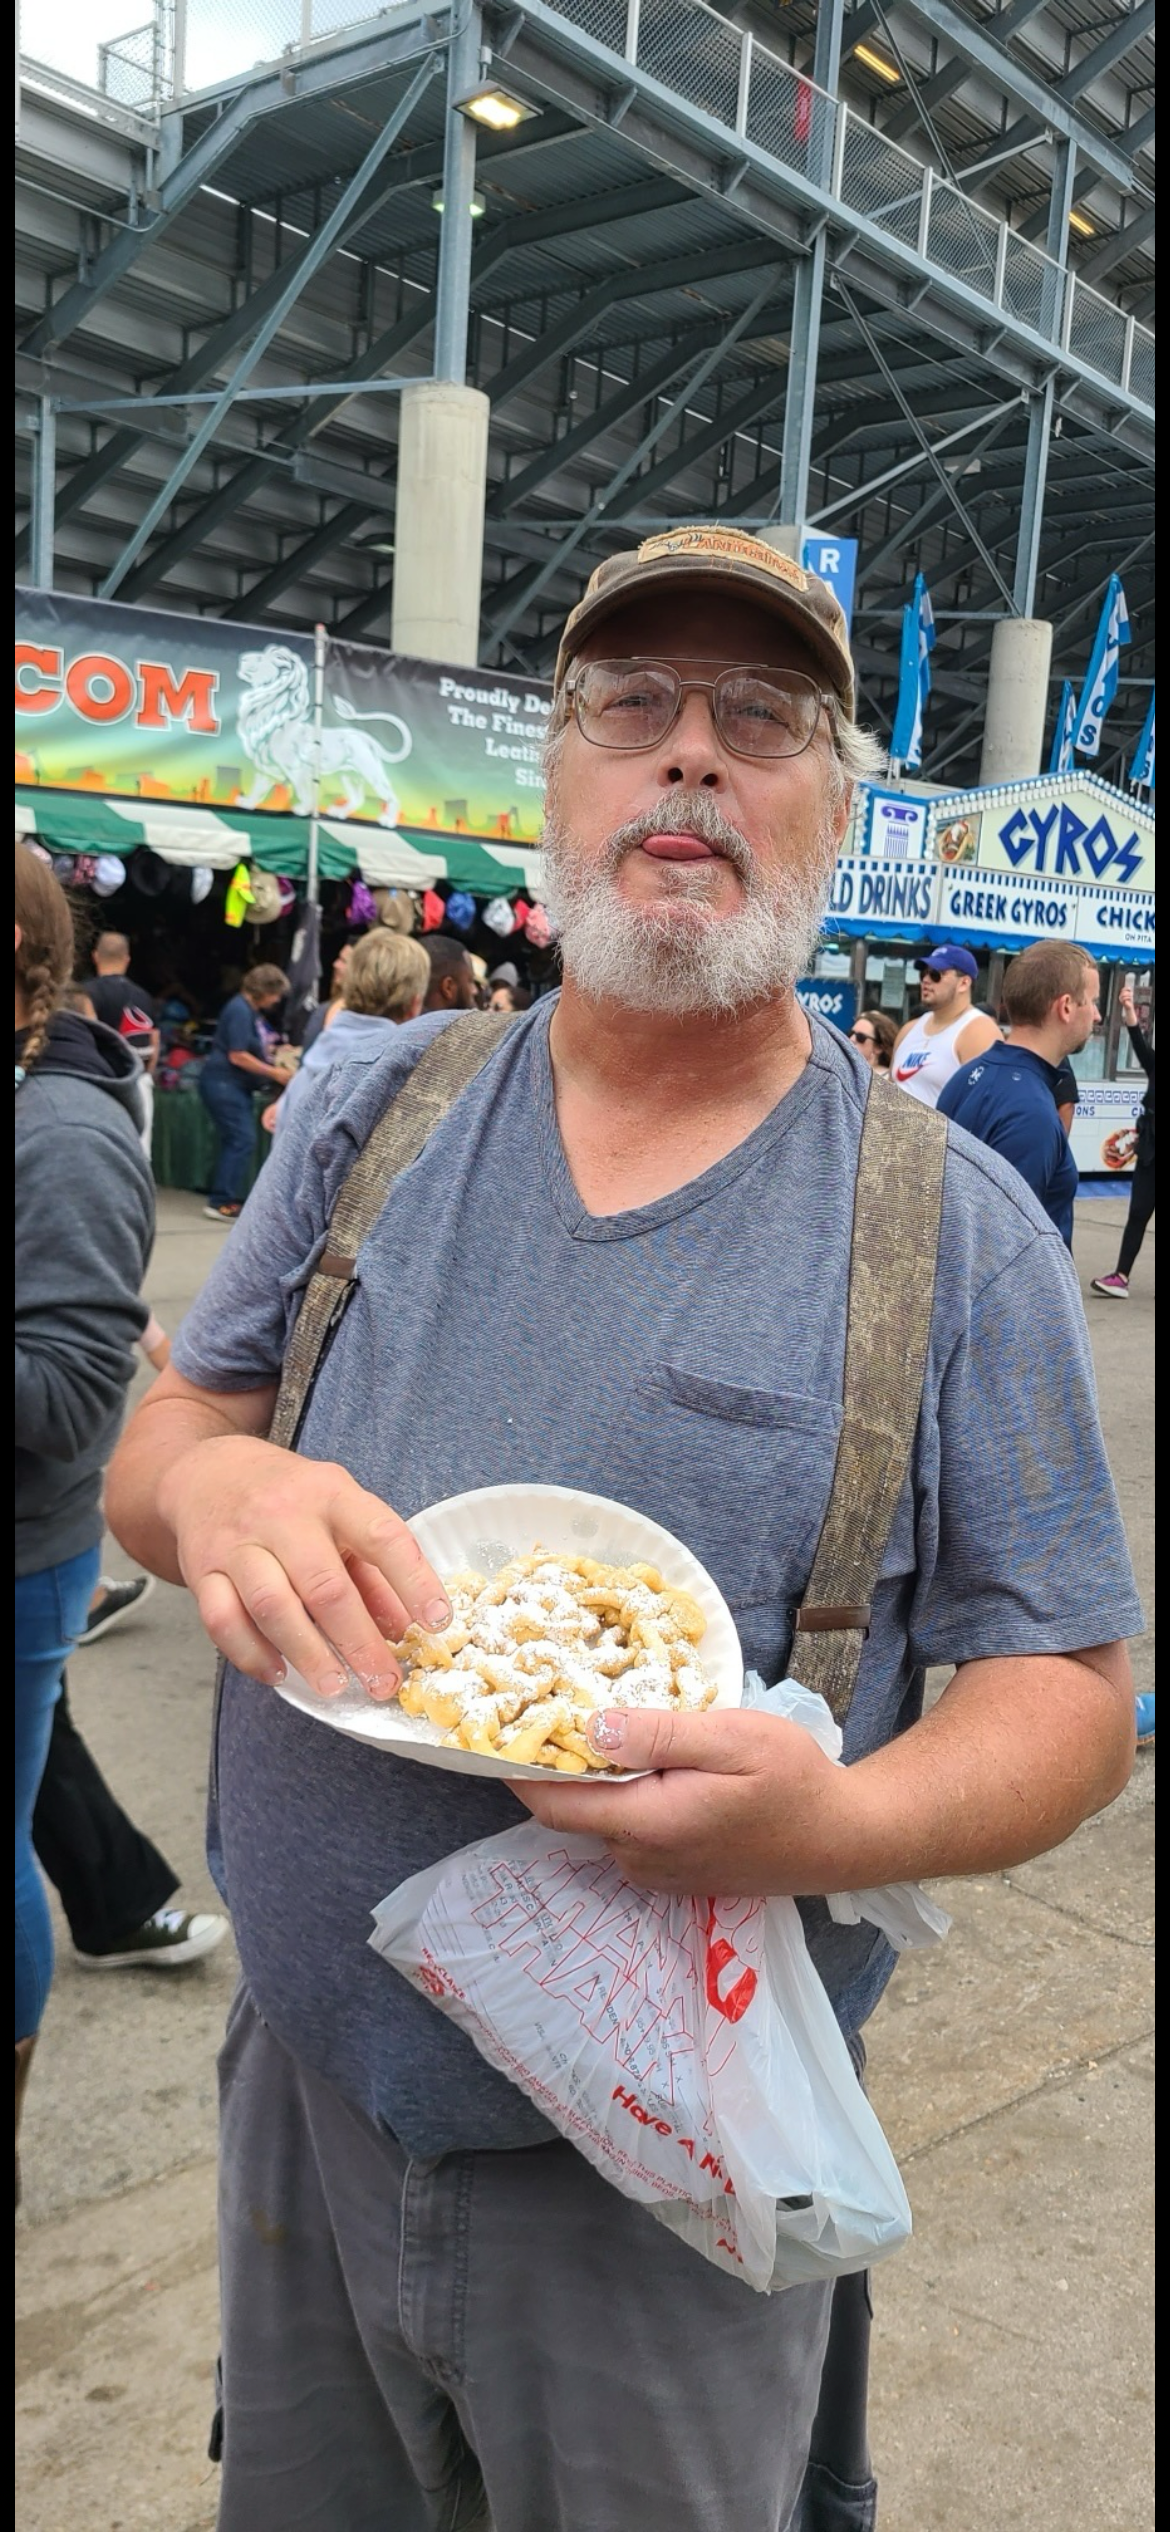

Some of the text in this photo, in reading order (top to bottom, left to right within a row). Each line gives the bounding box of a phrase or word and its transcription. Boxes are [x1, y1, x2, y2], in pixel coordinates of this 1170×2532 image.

[15, 640, 220, 737] COM
[439, 676, 555, 716] Proudly De
[447, 704, 550, 740] The Fines
[514, 767, 547, 790] Sin
[998, 801, 1144, 885] GYROS
[858, 873, 932, 920] DRINKS
[949, 888, 1068, 928] GREEK GYROS
[1096, 905, 1155, 932] CHICK
[801, 991, 843, 1015] YROS
[902, 1051, 931, 1069] NIKE
[1075, 1105, 1095, 1116] ONS
[612, 2085, 672, 2137] Have
